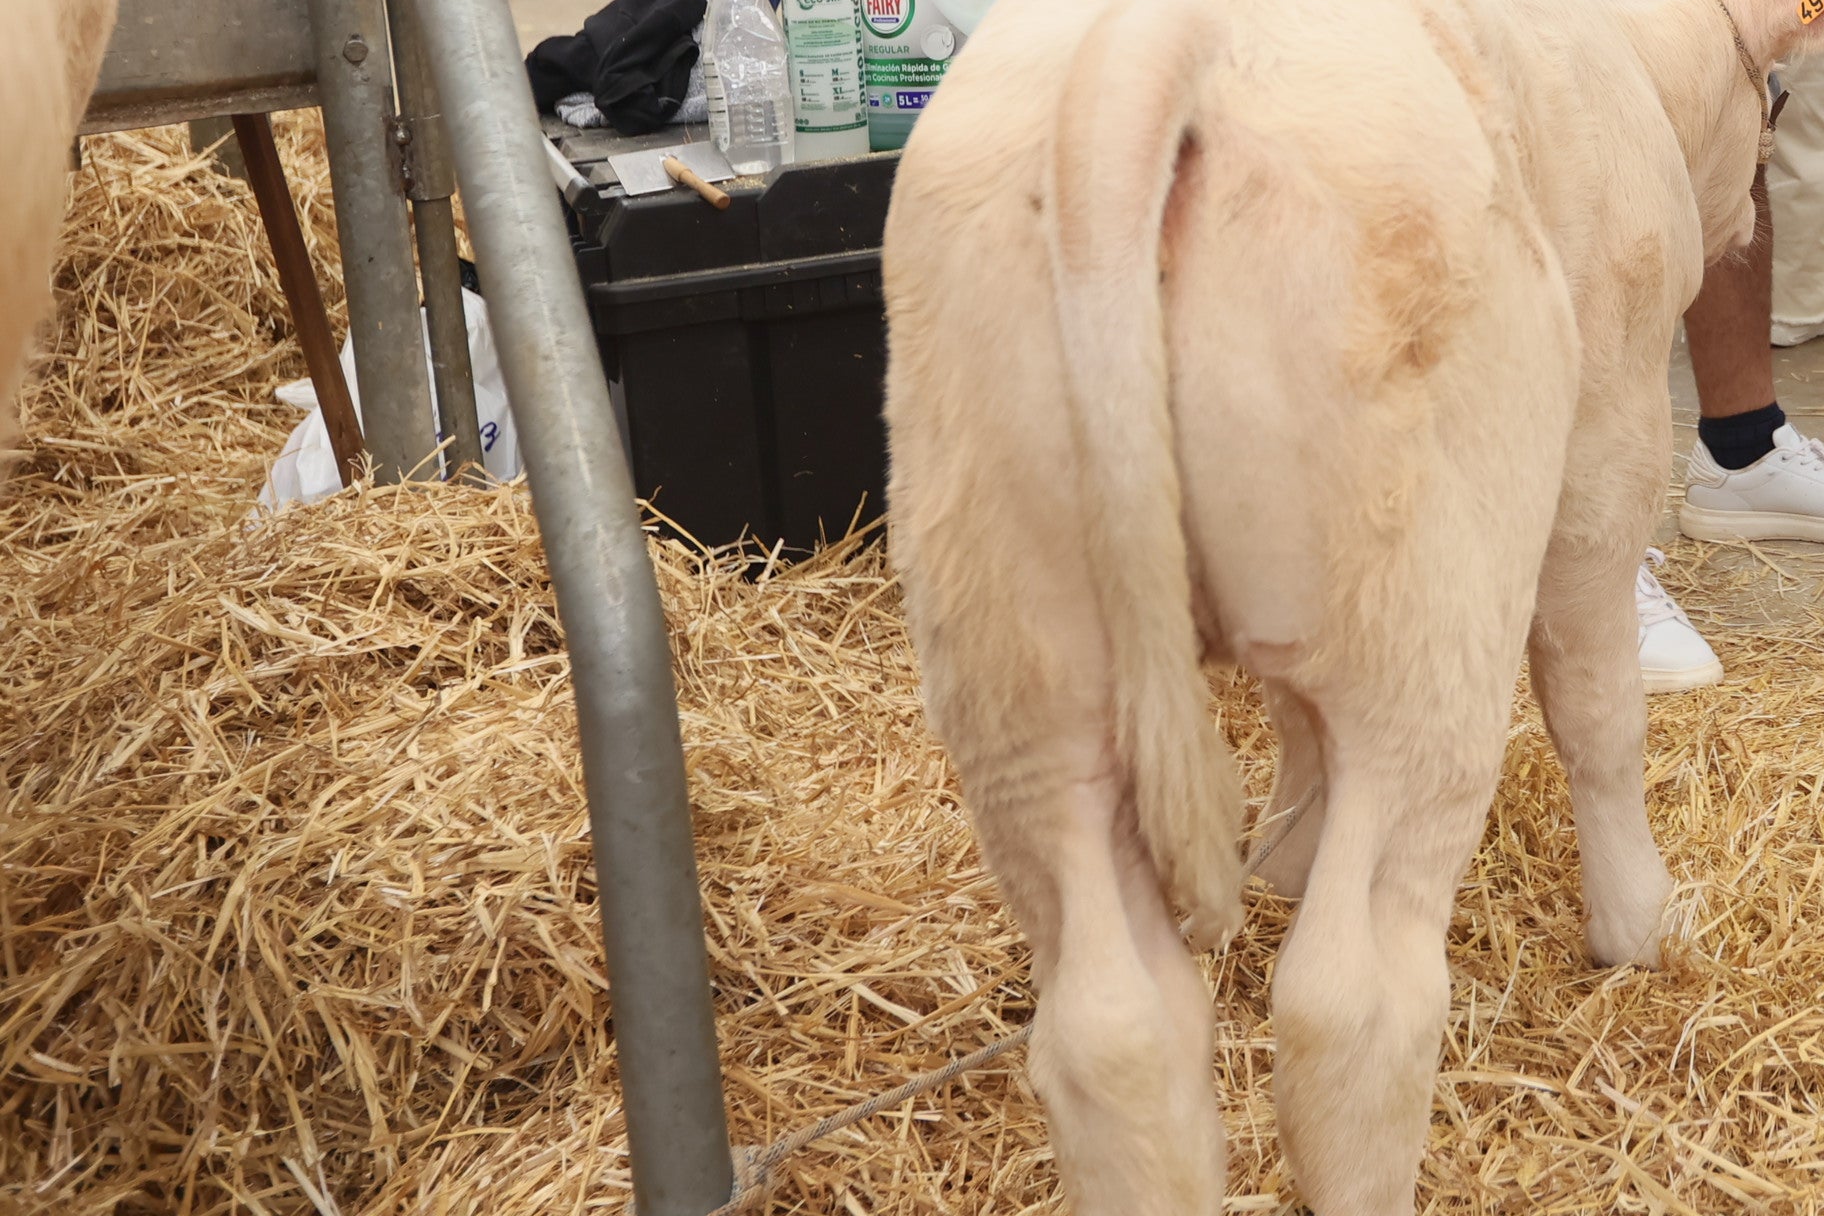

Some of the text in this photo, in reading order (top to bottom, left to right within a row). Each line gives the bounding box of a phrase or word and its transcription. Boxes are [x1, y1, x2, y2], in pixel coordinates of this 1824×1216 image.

[868, 45, 910, 54] REGULAR
[902, 63, 928, 74] Rápida
[930, 64, 940, 72] de
[872, 74, 898, 82] Cocinas
